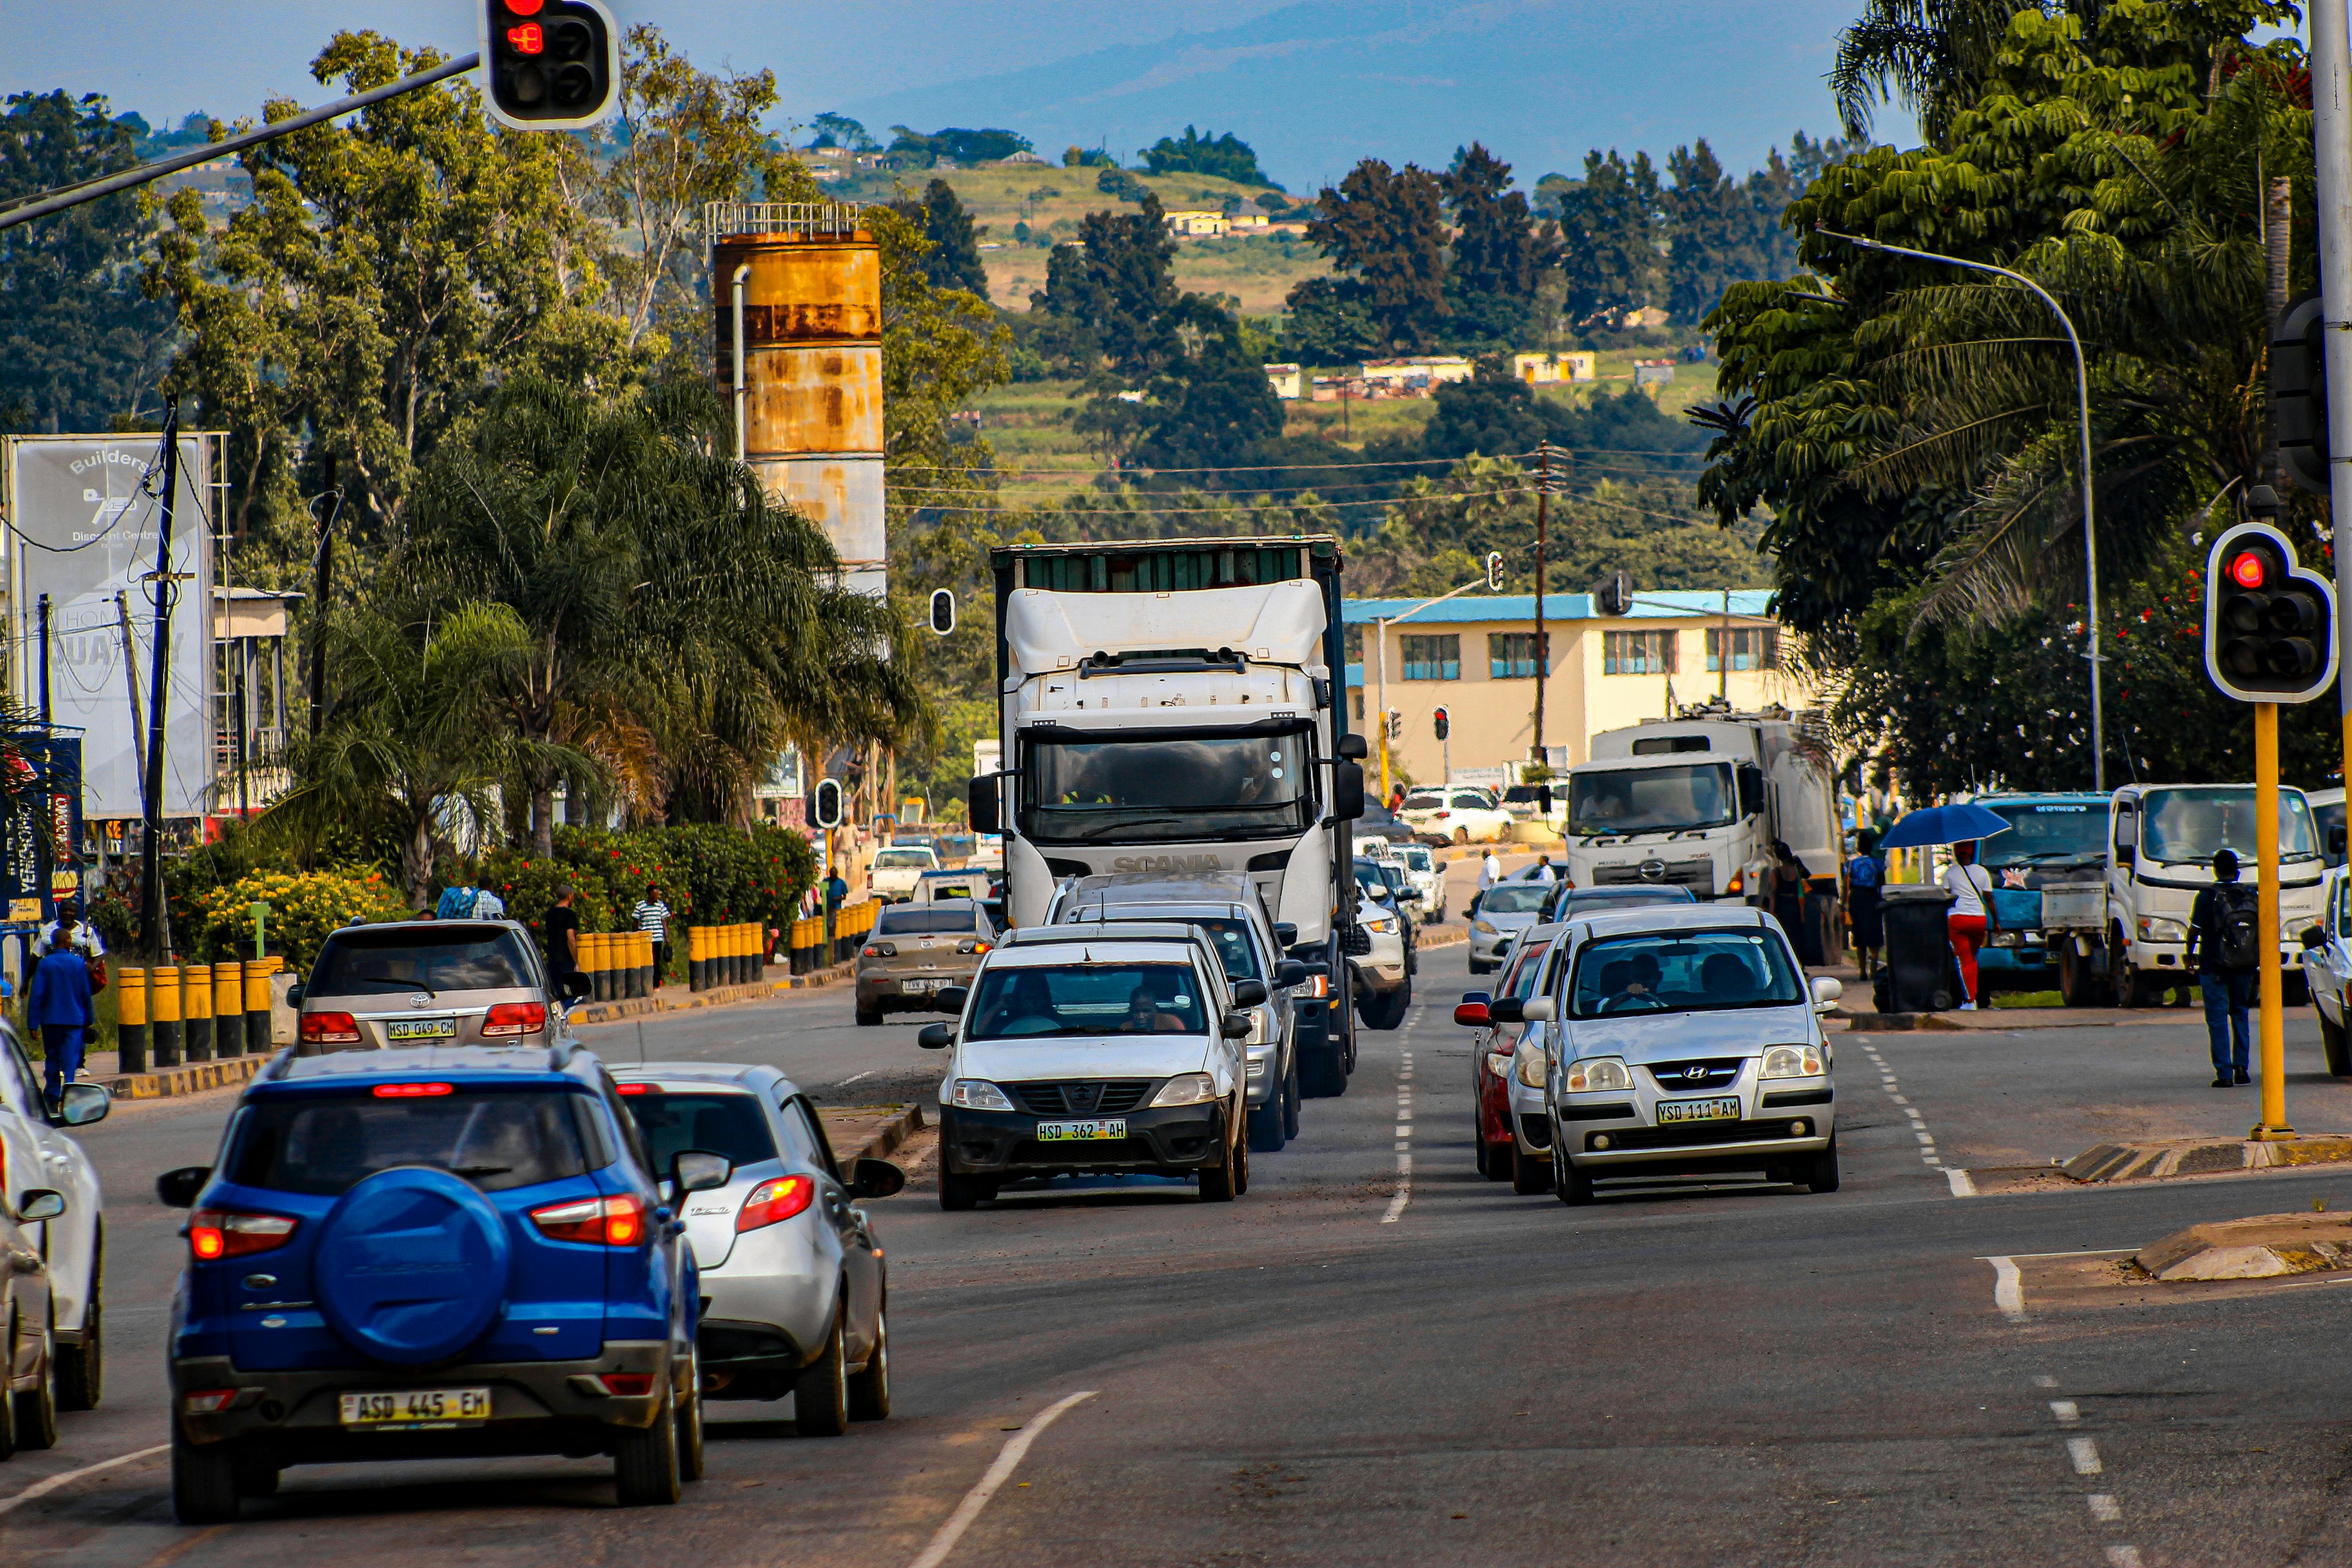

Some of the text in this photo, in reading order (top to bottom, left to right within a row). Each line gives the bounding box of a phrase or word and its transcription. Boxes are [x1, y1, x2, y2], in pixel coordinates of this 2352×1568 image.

[69, 450, 150, 475] Builders
[1113, 854, 1222, 873] SCANIA
[389, 1022, 454, 1036] MSD 049 CM
[1659, 1101, 1737, 1120] YSD 111 AM
[1039, 1122, 1124, 1139] HSD 362 AH
[358, 1396, 394, 1419] ASD
[408, 1393, 444, 1417] 445
